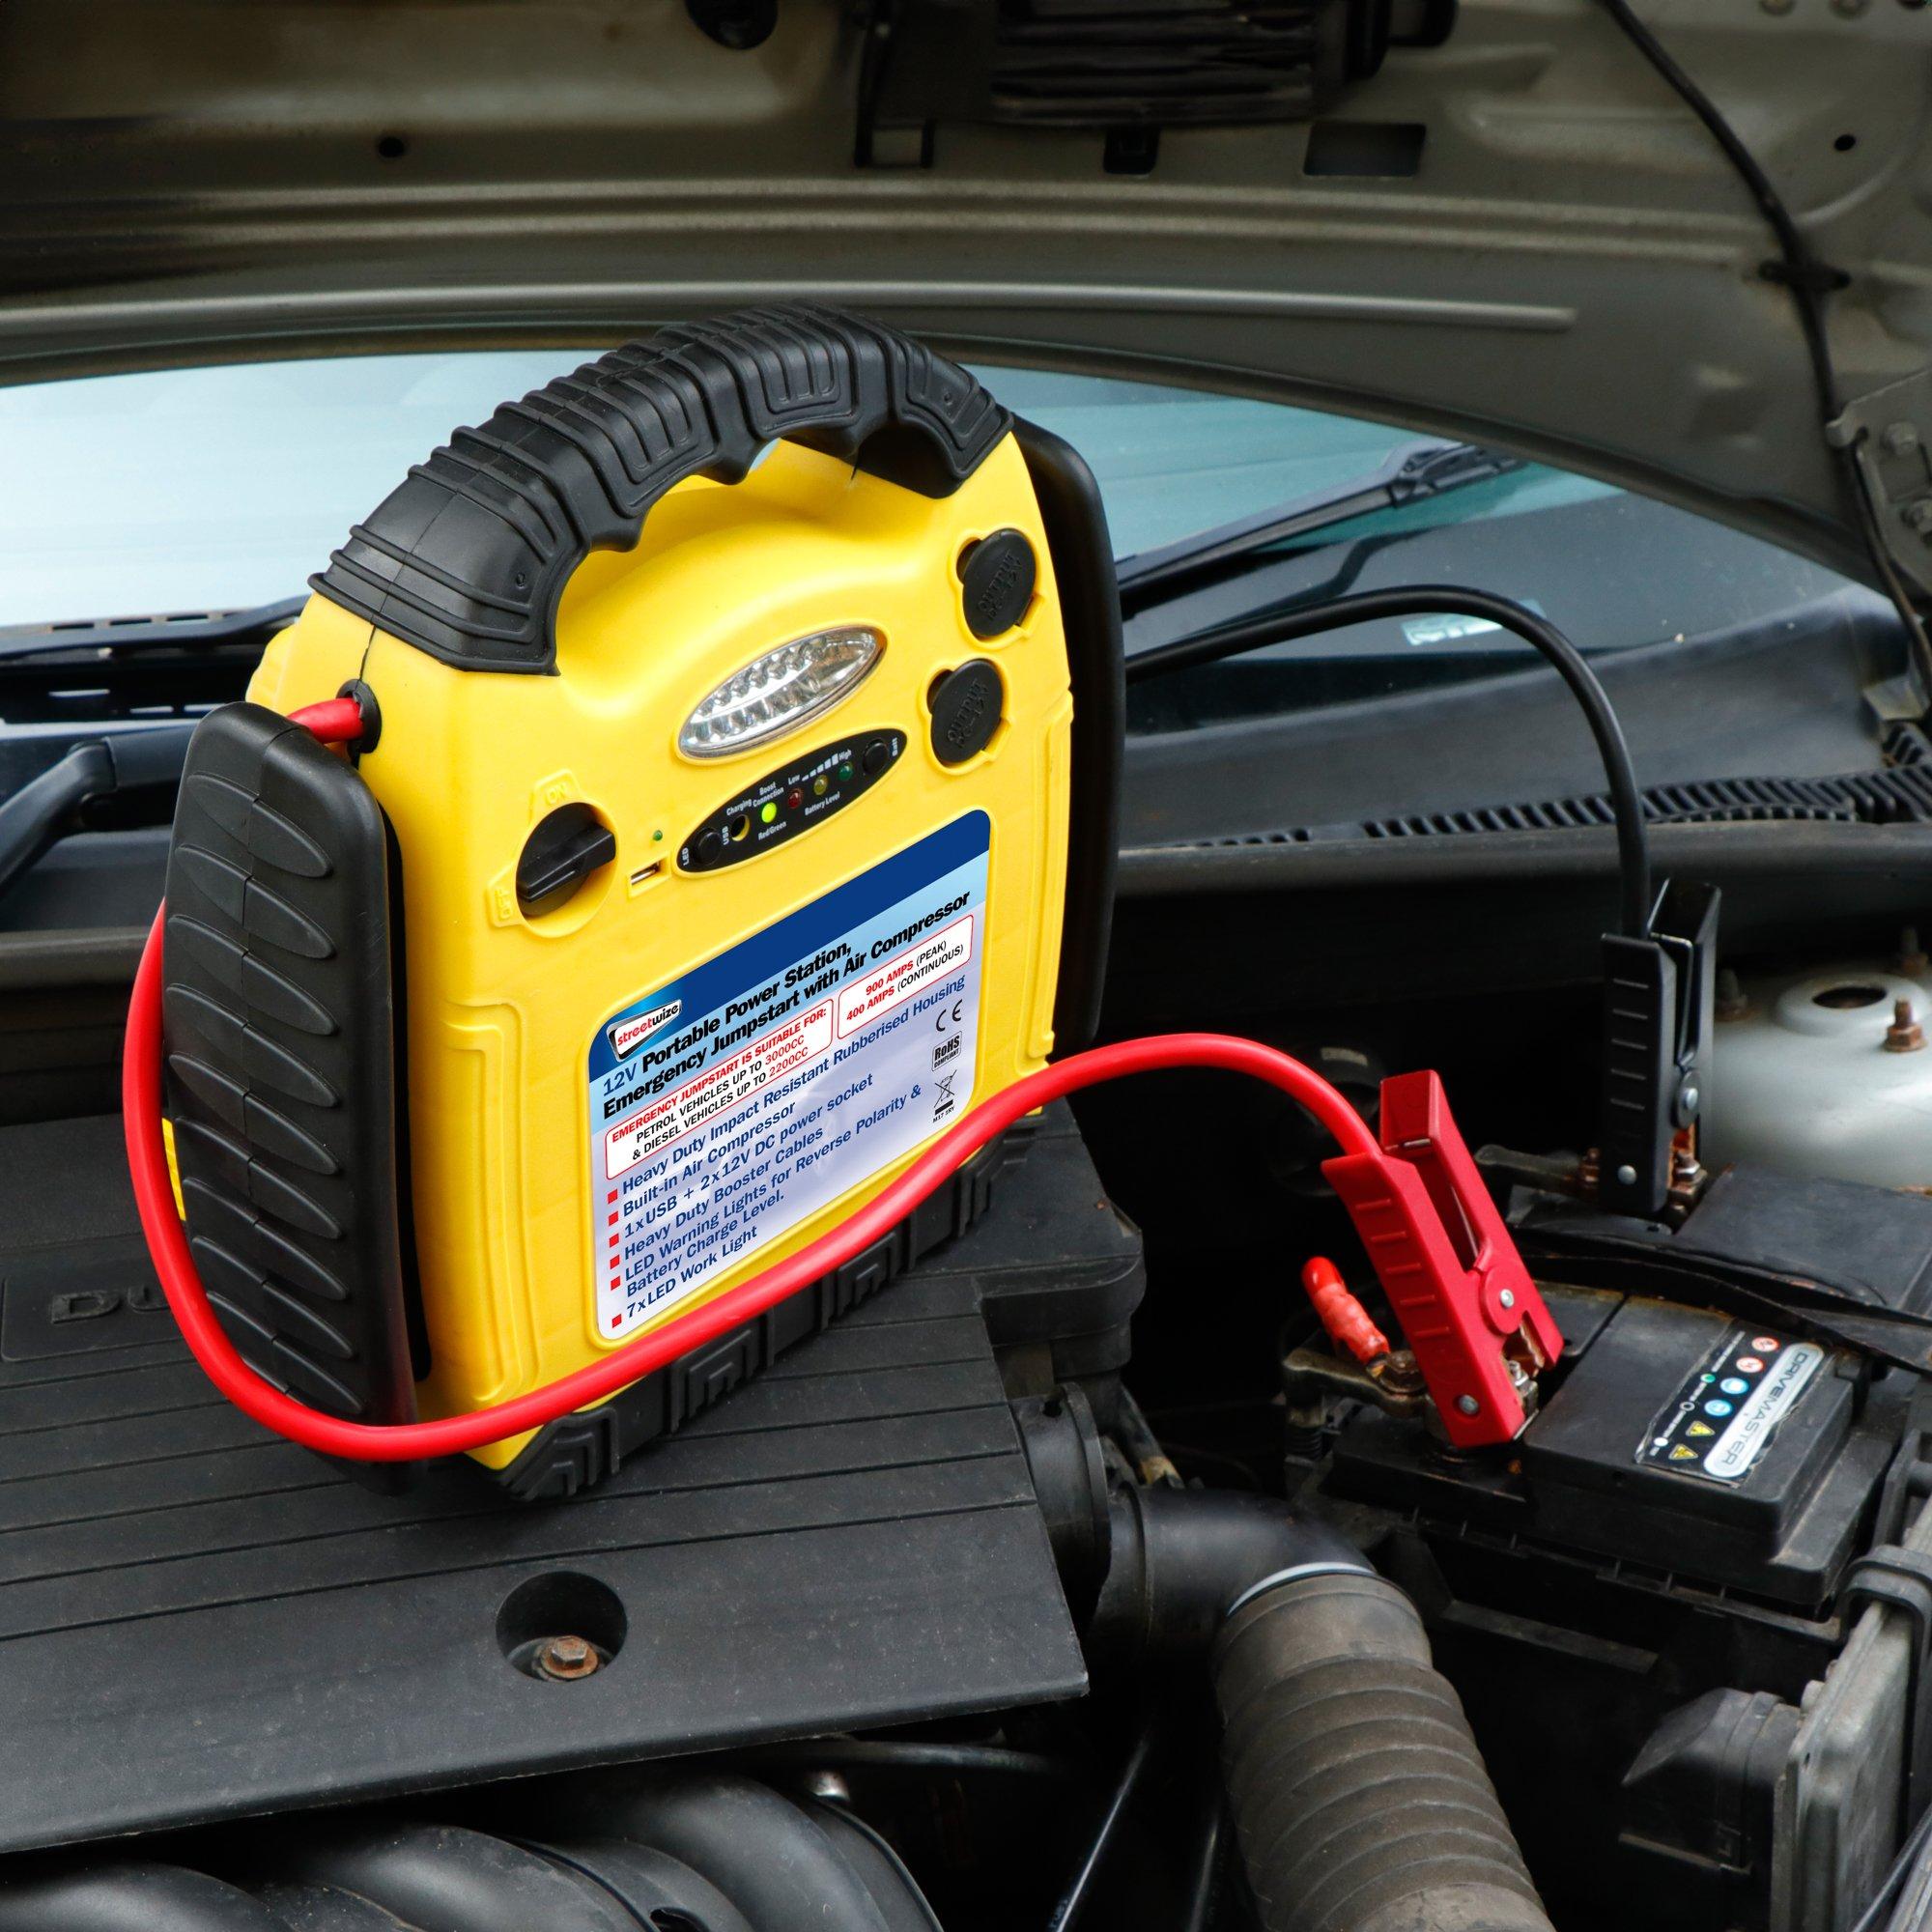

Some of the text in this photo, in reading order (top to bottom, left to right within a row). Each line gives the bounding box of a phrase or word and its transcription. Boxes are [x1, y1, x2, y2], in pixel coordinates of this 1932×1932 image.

[947, 677, 981, 743] OUTPUT
[759, 781, 777, 796] Boost
[788, 774, 801, 785] Low
[838, 749, 852, 762] High
[726, 798, 753, 816] Charging
[753, 786, 784, 808] Connection
[805, 790, 840, 816] Battery Level
[603, 891, 971, 1121] Emergency Jumpstart with Air Compressor
[846, 944, 964, 1021] 400 AMPS (CONTINUOUS)
[866, 940, 947, 996] 900 AMPS (PEAK)
[603, 942, 852, 1097] 12V Portable Power Station,
[617, 1003, 679, 1046] streetwize
[934, 1035, 960, 1062] RoHS
[935, 998, 963, 1033] CE
[611, 1009, 827, 1143] EMERGENCY JUMPSTART IS SUITABLE FOR:
[622, 975, 966, 1195] Heavy Duty Impact Resistant Rubberised Housing
[632, 1046, 809, 1161] & DIESEL VEHICLES UP TO 2200CC
[637, 1034, 805, 1144] PETROL VEHICLES UP TO 3000CC
[623, 1101, 796, 1217] Built-in Air Compressor
[683, 1187, 695, 1200] +
[754, 1133, 776, 1157] DC
[780, 1105, 823, 1145] power
[827, 1073, 873, 1112] socket
[624, 1127, 823, 1261] Heavy Duty Booster Cables
[625, 1084, 922, 1282] LED Warning Lights for Reverse Polarity &
[627, 1188, 784, 1298] Battery Charge Level.
[680, 1252, 718, 1283] Work
[722, 1225, 757, 1258] Light
[1721, 1350, 1808, 1465] DRIVEMASTER
